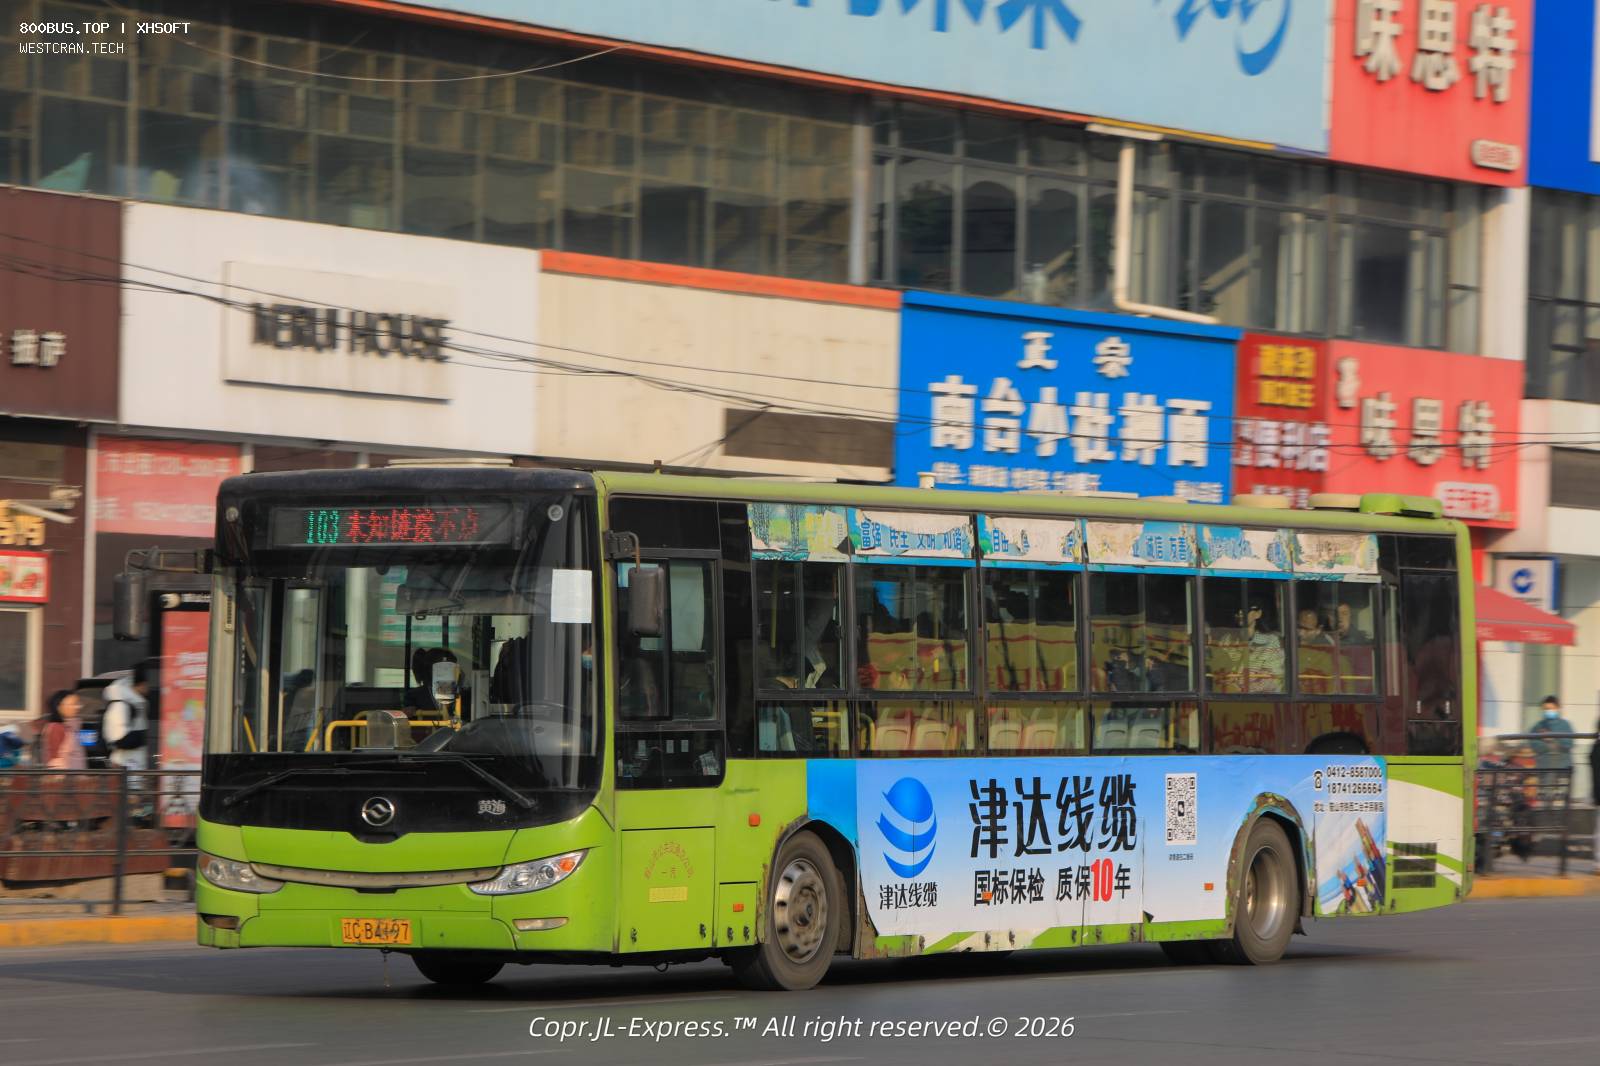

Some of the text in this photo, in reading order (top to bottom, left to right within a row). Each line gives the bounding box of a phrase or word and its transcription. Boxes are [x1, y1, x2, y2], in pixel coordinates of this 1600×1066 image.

[306, 510, 340, 544] 103
[477, 799, 506, 815] 黄海
[968, 774, 1138, 859] 津达线缆
[879, 882, 939, 910] 津达线缆
[973, 857, 1132, 907] 国标保检 质保10年
